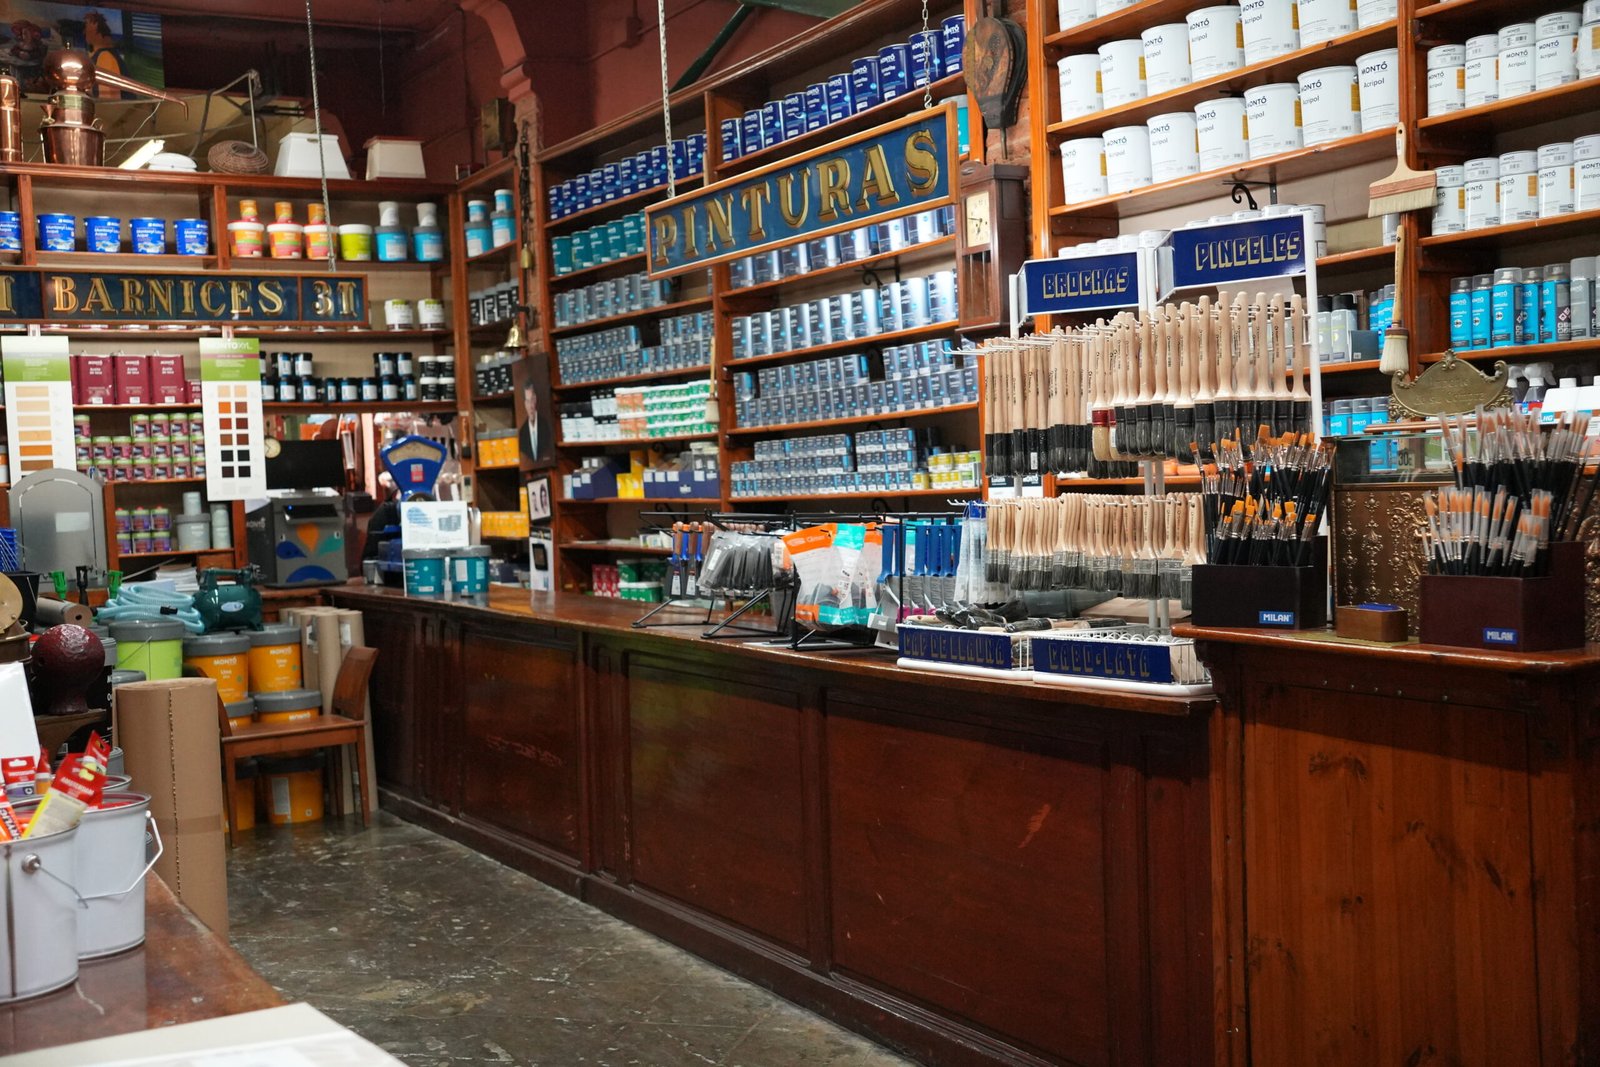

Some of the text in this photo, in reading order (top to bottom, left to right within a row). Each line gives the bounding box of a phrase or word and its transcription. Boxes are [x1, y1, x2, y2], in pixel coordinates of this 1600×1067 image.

[1506, 50, 1528, 59] MONTÓ
[1361, 61, 1388, 75] MONTÓ
[654, 128, 940, 266] PINTURAS
[1195, 230, 1302, 271] PINCELES
[1043, 265, 1130, 299] BROCHAS
[51, 276, 284, 318] BARNICES
[1263, 613, 1290, 622] MILAN
[1486, 630, 1514, 641] MILAN
